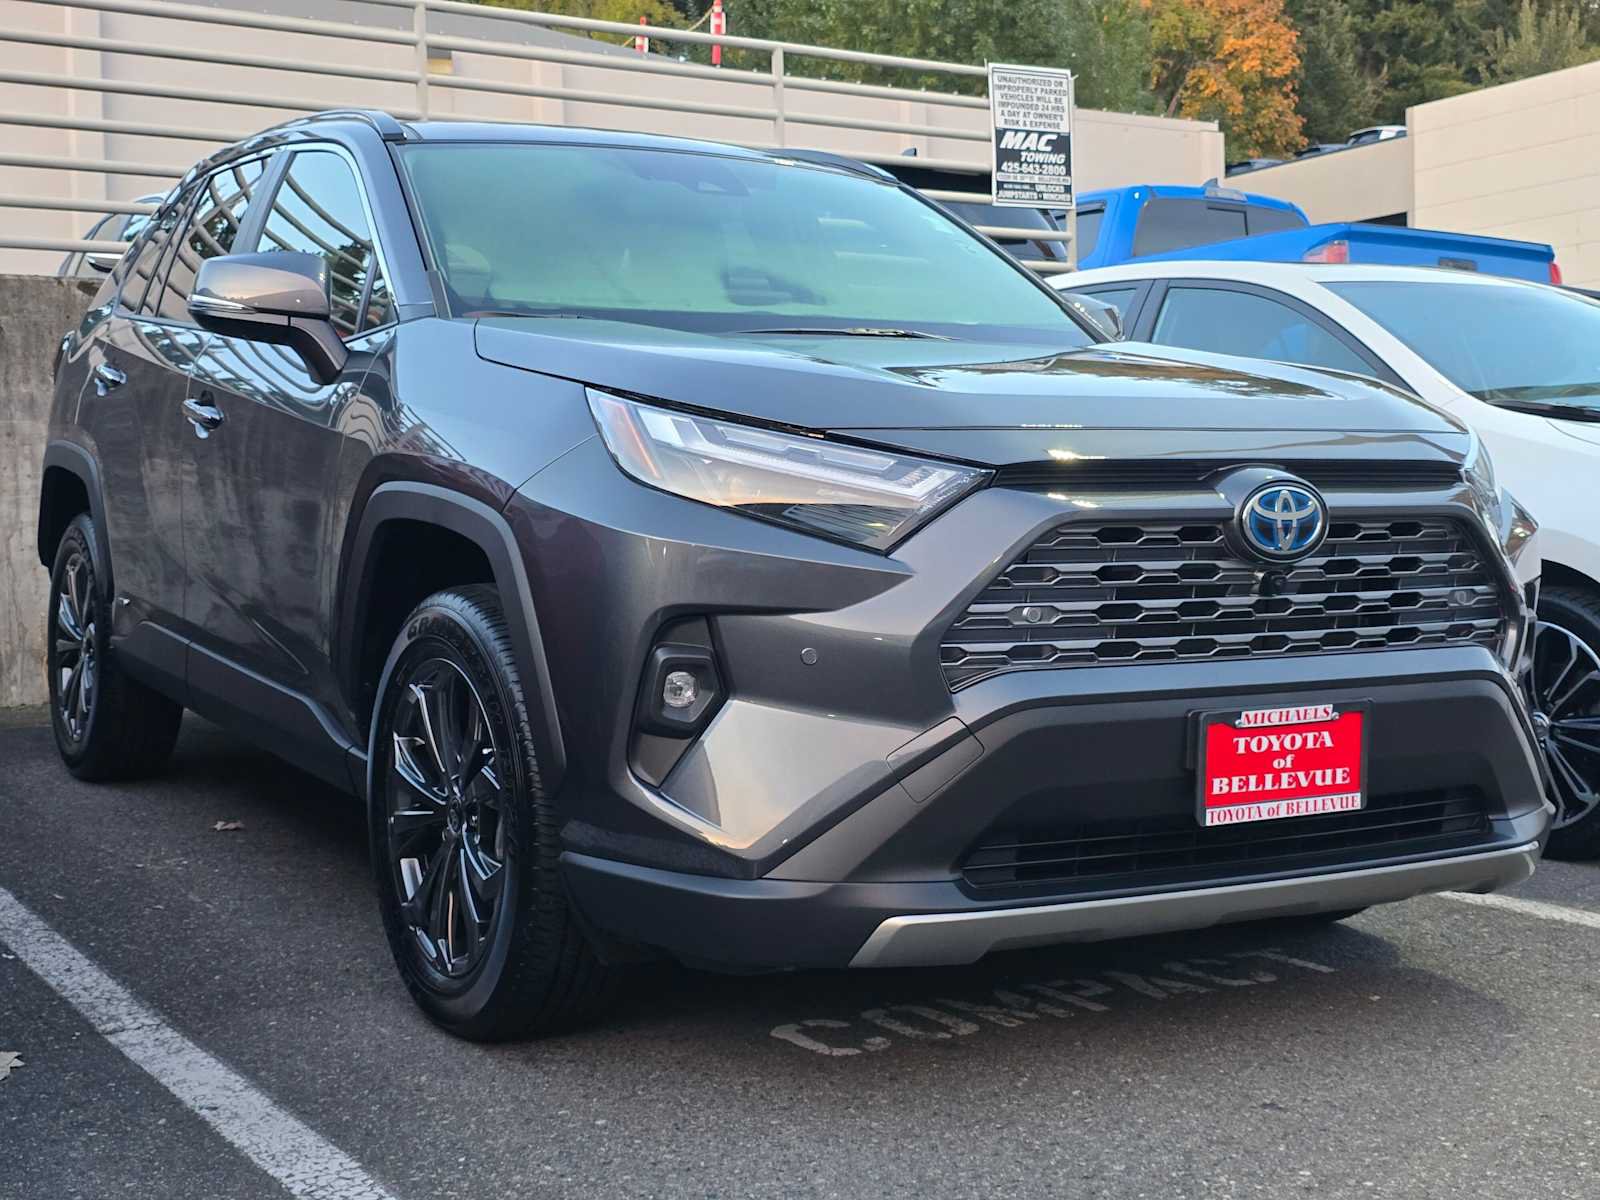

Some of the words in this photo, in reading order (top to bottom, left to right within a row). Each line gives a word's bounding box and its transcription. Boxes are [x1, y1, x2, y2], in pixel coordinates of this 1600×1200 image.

[997, 75, 1052, 86] UNAUTHORIZED
[994, 84, 1038, 94] IMPROPERLY
[1040, 88, 1067, 96] PARKED
[1001, 93, 1034, 101] VEHICLES
[998, 101, 1039, 110] IMPOUNDED
[1004, 118, 1020, 126] RISK
[1030, 120, 1061, 129] EXPENSE
[1032, 112, 1064, 121] OWNER'S
[1000, 131, 1058, 152] MAC
[1020, 152, 1066, 164] TOWING
[1001, 161, 1066, 175] 425-643-2800
[1242, 706, 1331, 725] MICHAELS
[1232, 730, 1334, 754] TOYOTA
[1272, 754, 1295, 770] of
[1212, 767, 1350, 795] BELLEVUE
[1208, 805, 1264, 824] TOYOTA
[1268, 804, 1281, 816] of
[1286, 795, 1360, 815] BELLEVUE
[769, 947, 1336, 1056] COMPACT
